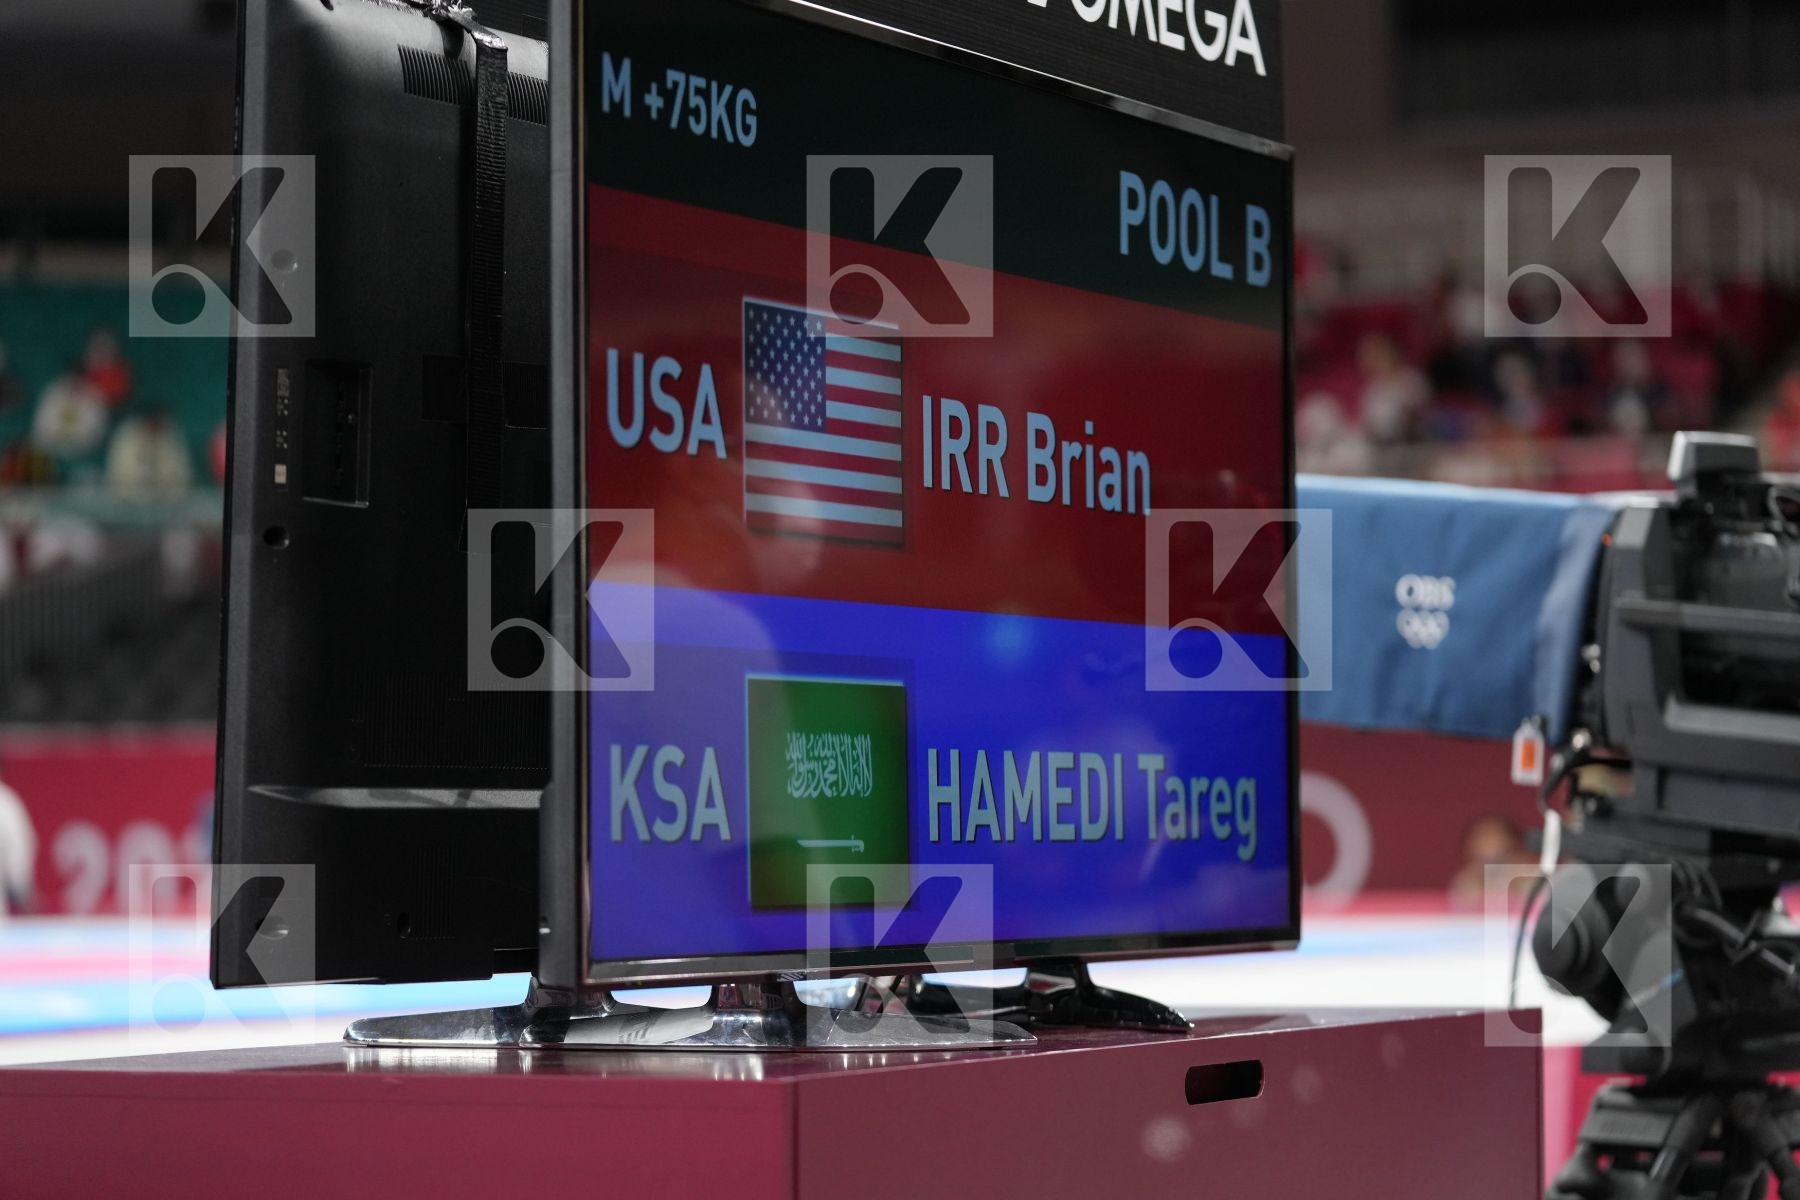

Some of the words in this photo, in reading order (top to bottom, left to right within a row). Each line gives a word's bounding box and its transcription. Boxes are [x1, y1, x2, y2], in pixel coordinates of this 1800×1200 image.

[602, 51, 631, 118] M
[644, 68, 758, 147] +75KG
[1120, 170, 1234, 280] POOL
[1246, 204, 1272, 288] B
[606, 348, 727, 459] USA
[922, 395, 1010, 498] IRR
[1027, 412, 1151, 516] Brian
[610, 744, 731, 842] KSA
[928, 748, 1124, 842] HAMEDI
[1137, 753, 1257, 862] Tareg
